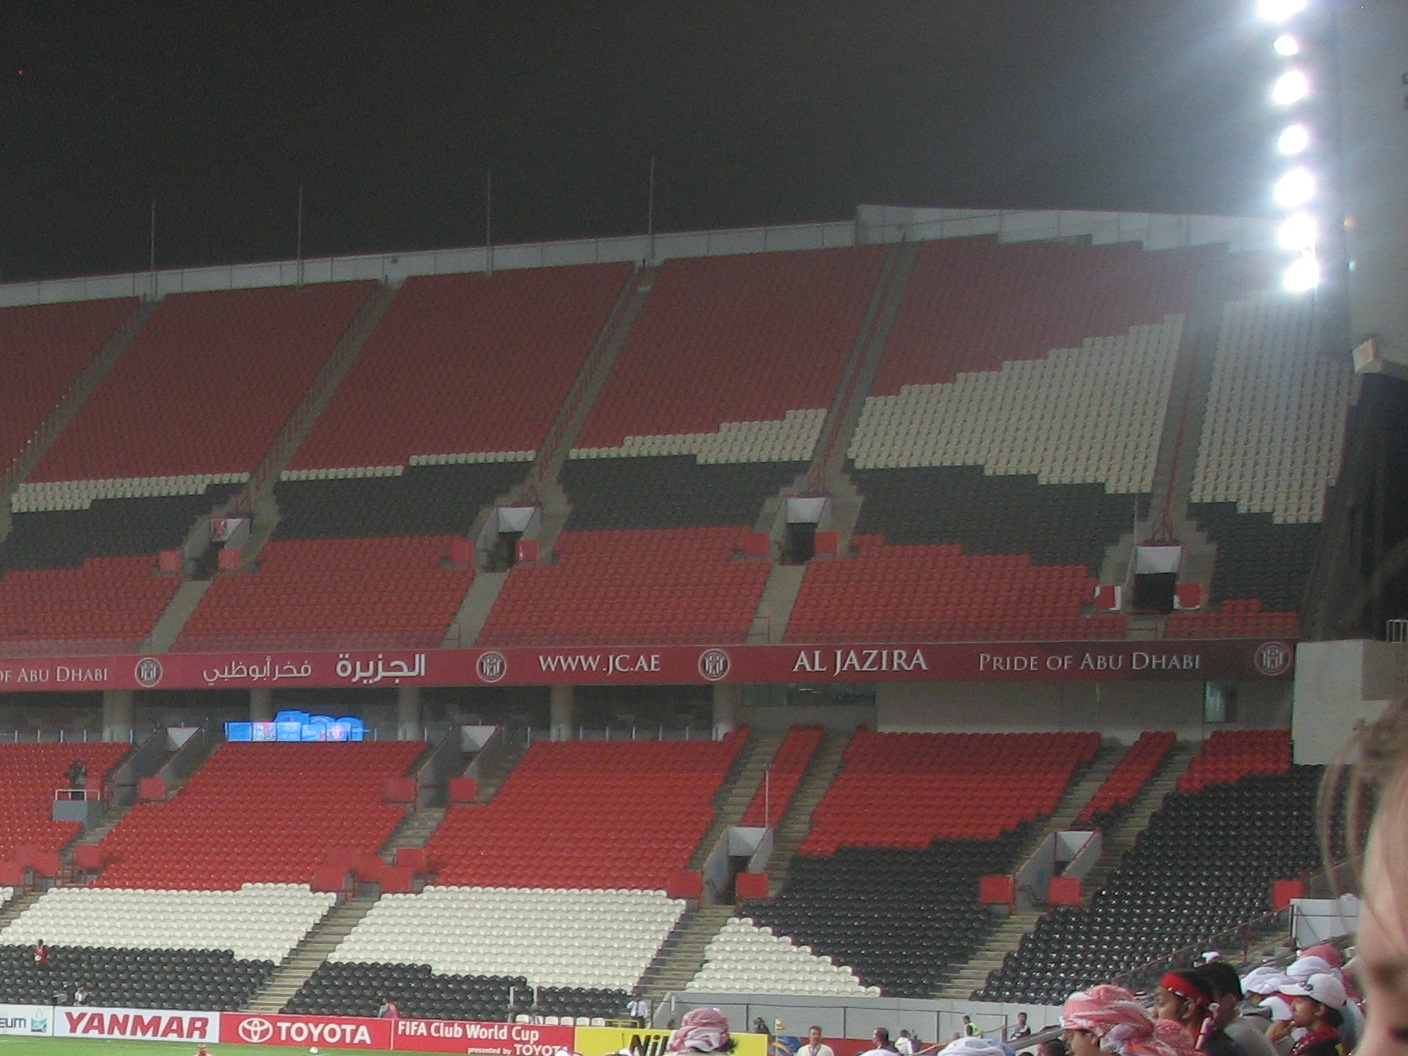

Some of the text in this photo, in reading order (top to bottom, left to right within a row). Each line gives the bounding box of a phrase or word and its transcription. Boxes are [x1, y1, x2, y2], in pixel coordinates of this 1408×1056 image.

[273, 660, 312, 681] فخر
[336, 653, 426, 684] الجزيرة
[538, 654, 661, 676] WWW.JC.AE
[792, 648, 929, 677] AL JAZIRA
[64, 1011, 209, 1040] YANMAR
[276, 1021, 373, 1046] TOYOTA
[397, 1020, 540, 1043] FIFA Club World Cup
[468, 1046, 502, 1056] presented
[503, 1047, 512, 1056] by
